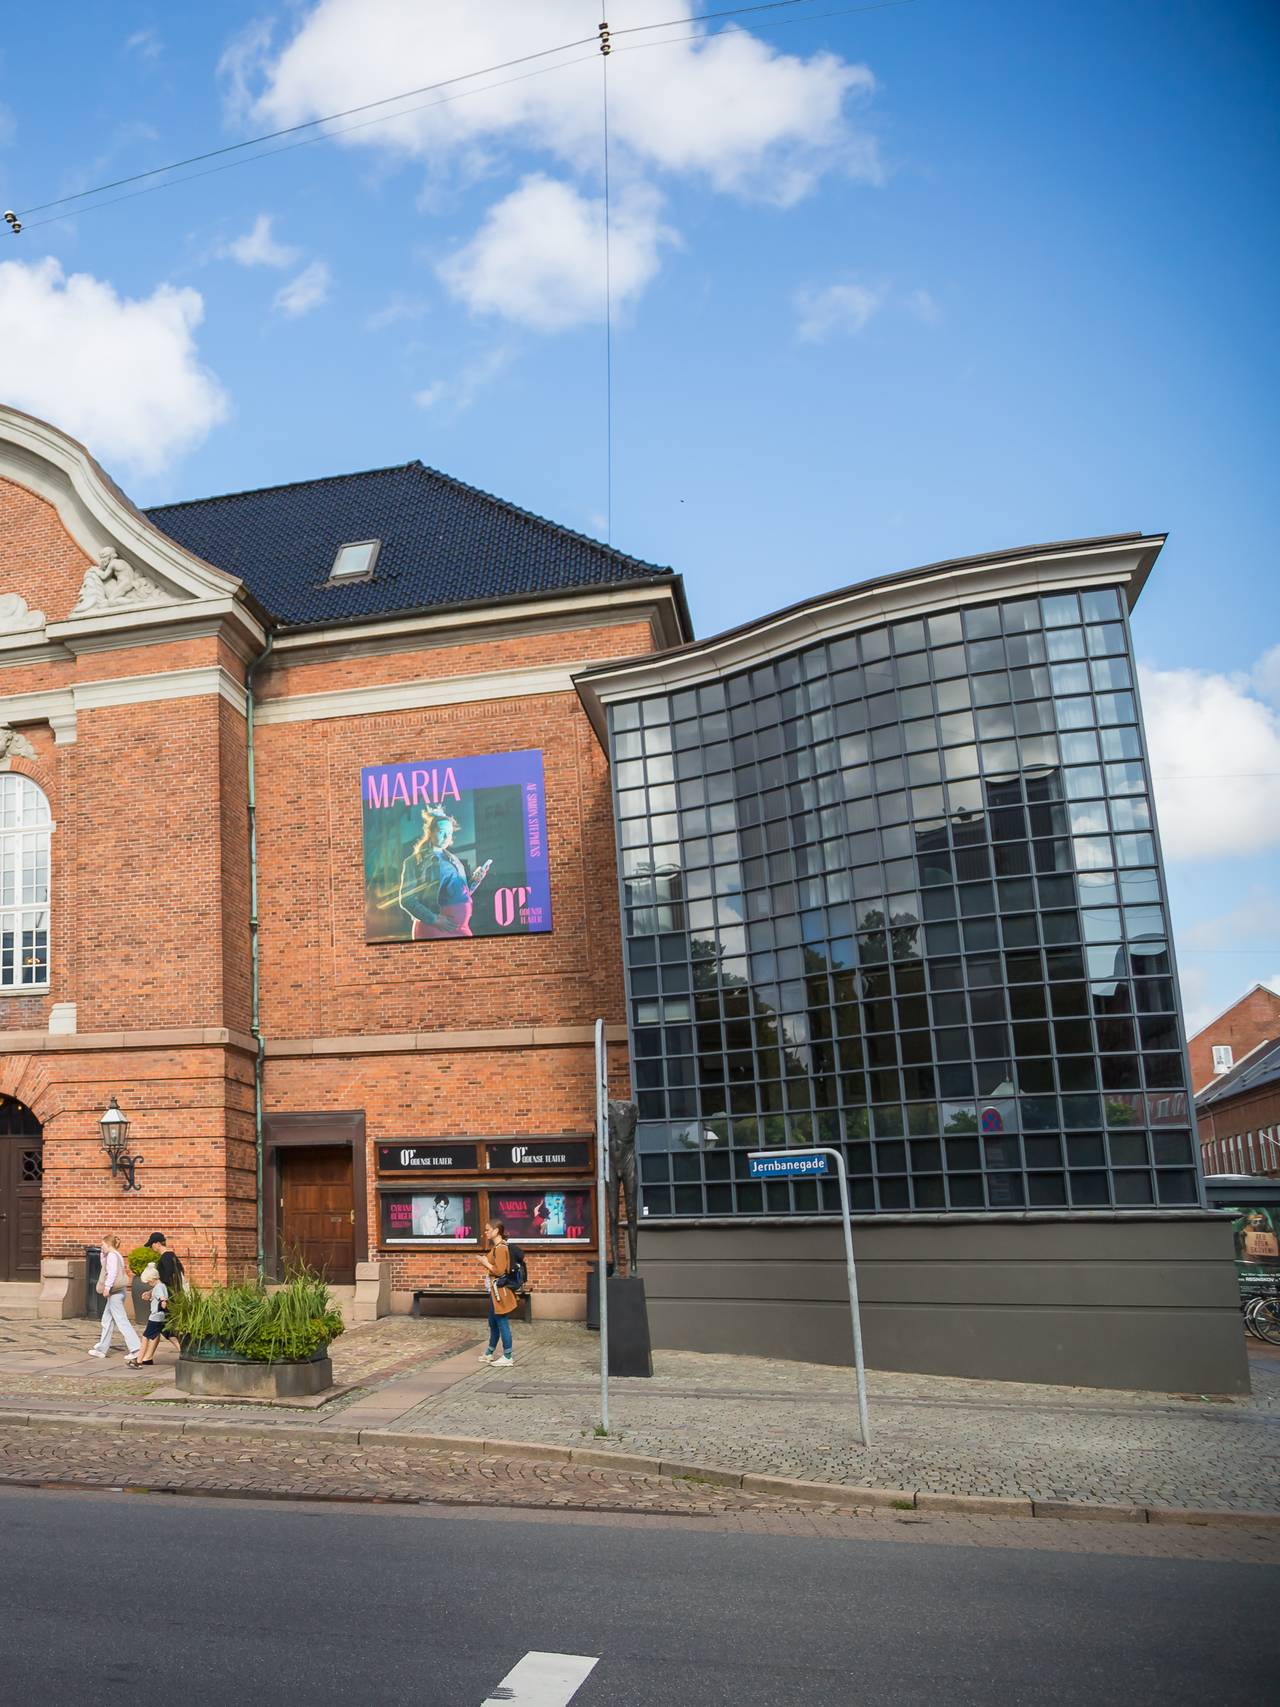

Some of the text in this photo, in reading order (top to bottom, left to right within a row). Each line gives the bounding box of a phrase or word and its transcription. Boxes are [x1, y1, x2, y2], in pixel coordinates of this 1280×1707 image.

[368, 767, 461, 809] MARIA
[494, 886, 532, 926] OT
[400, 1149, 453, 1166] OT ODENSE TEATER
[511, 1146, 566, 1163] OT ODENSE TEATER
[752, 1158, 825, 1172] Jernbanegade
